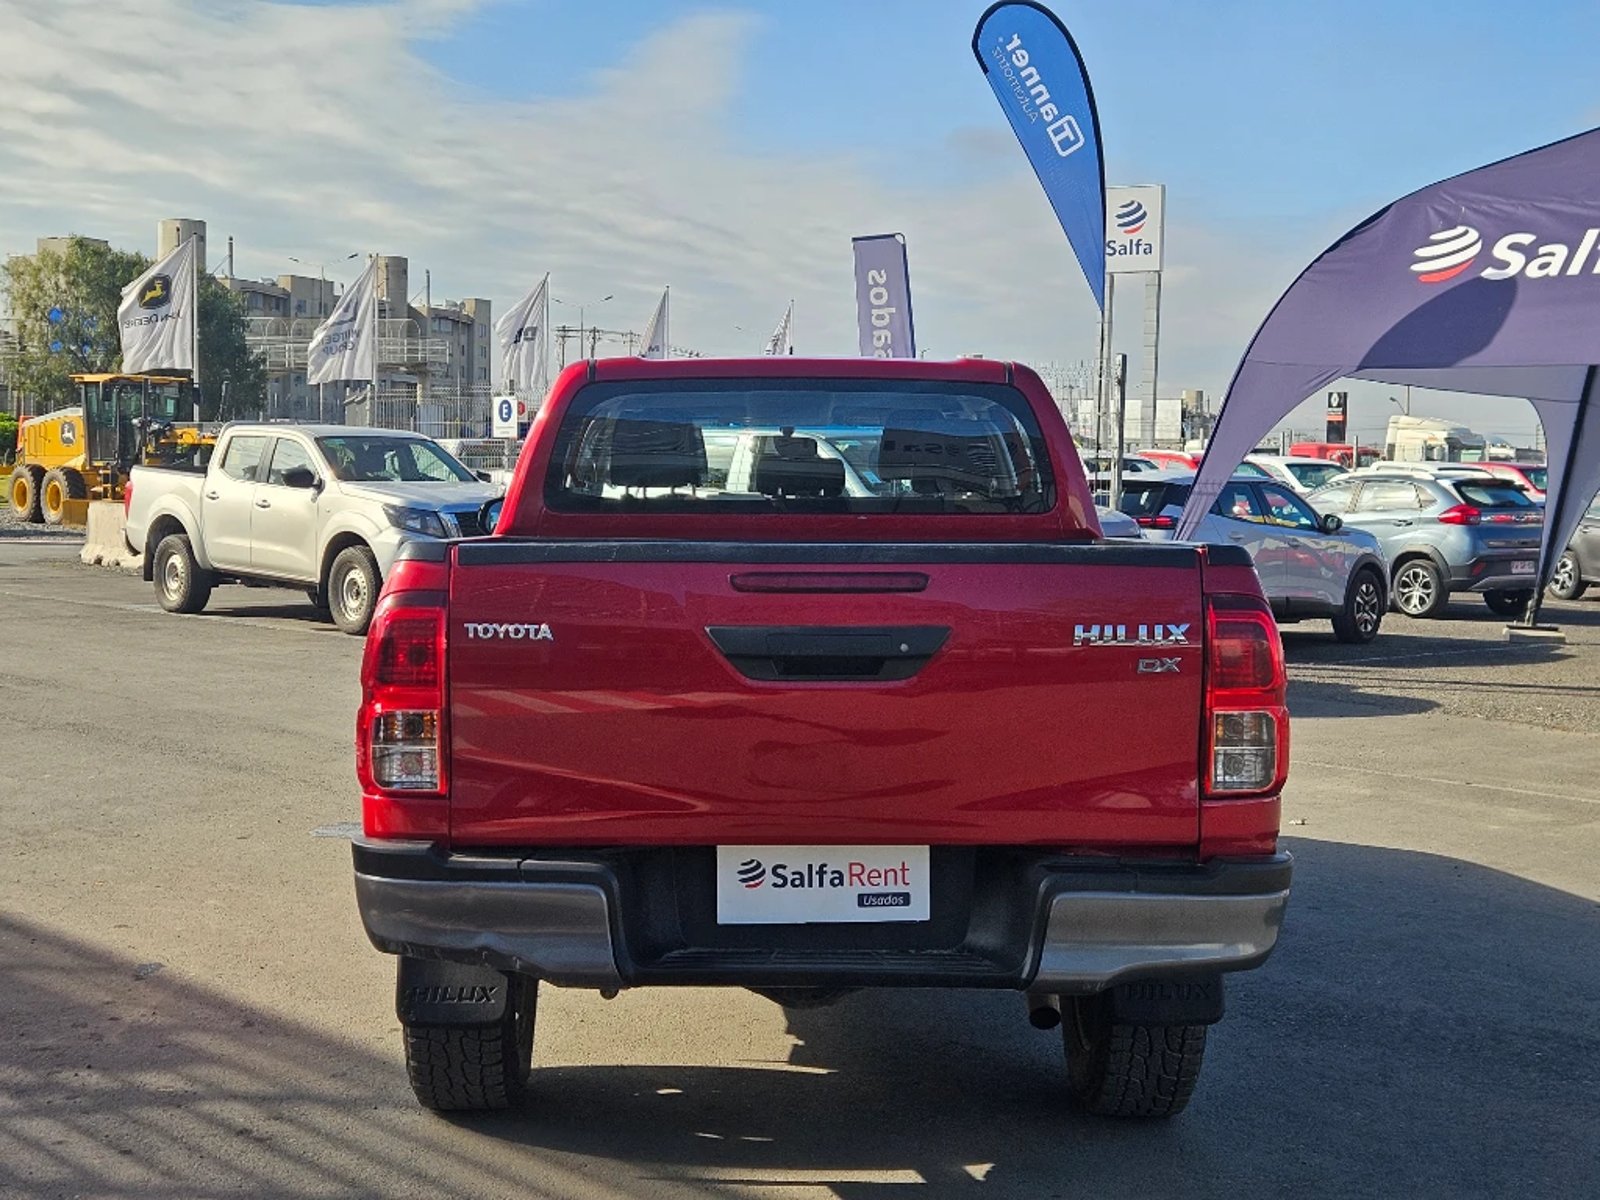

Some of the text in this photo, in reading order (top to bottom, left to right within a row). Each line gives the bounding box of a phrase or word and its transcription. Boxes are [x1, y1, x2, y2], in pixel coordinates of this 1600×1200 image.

[1105, 238, 1153, 257] Salfa
[501, 403, 509, 419] E
[463, 622, 554, 641] TOYOTA
[1073, 623, 1191, 646] HILUX
[1137, 657, 1182, 674] DX
[862, 894, 905, 907] Usados
[411, 985, 499, 1004] HILUX
